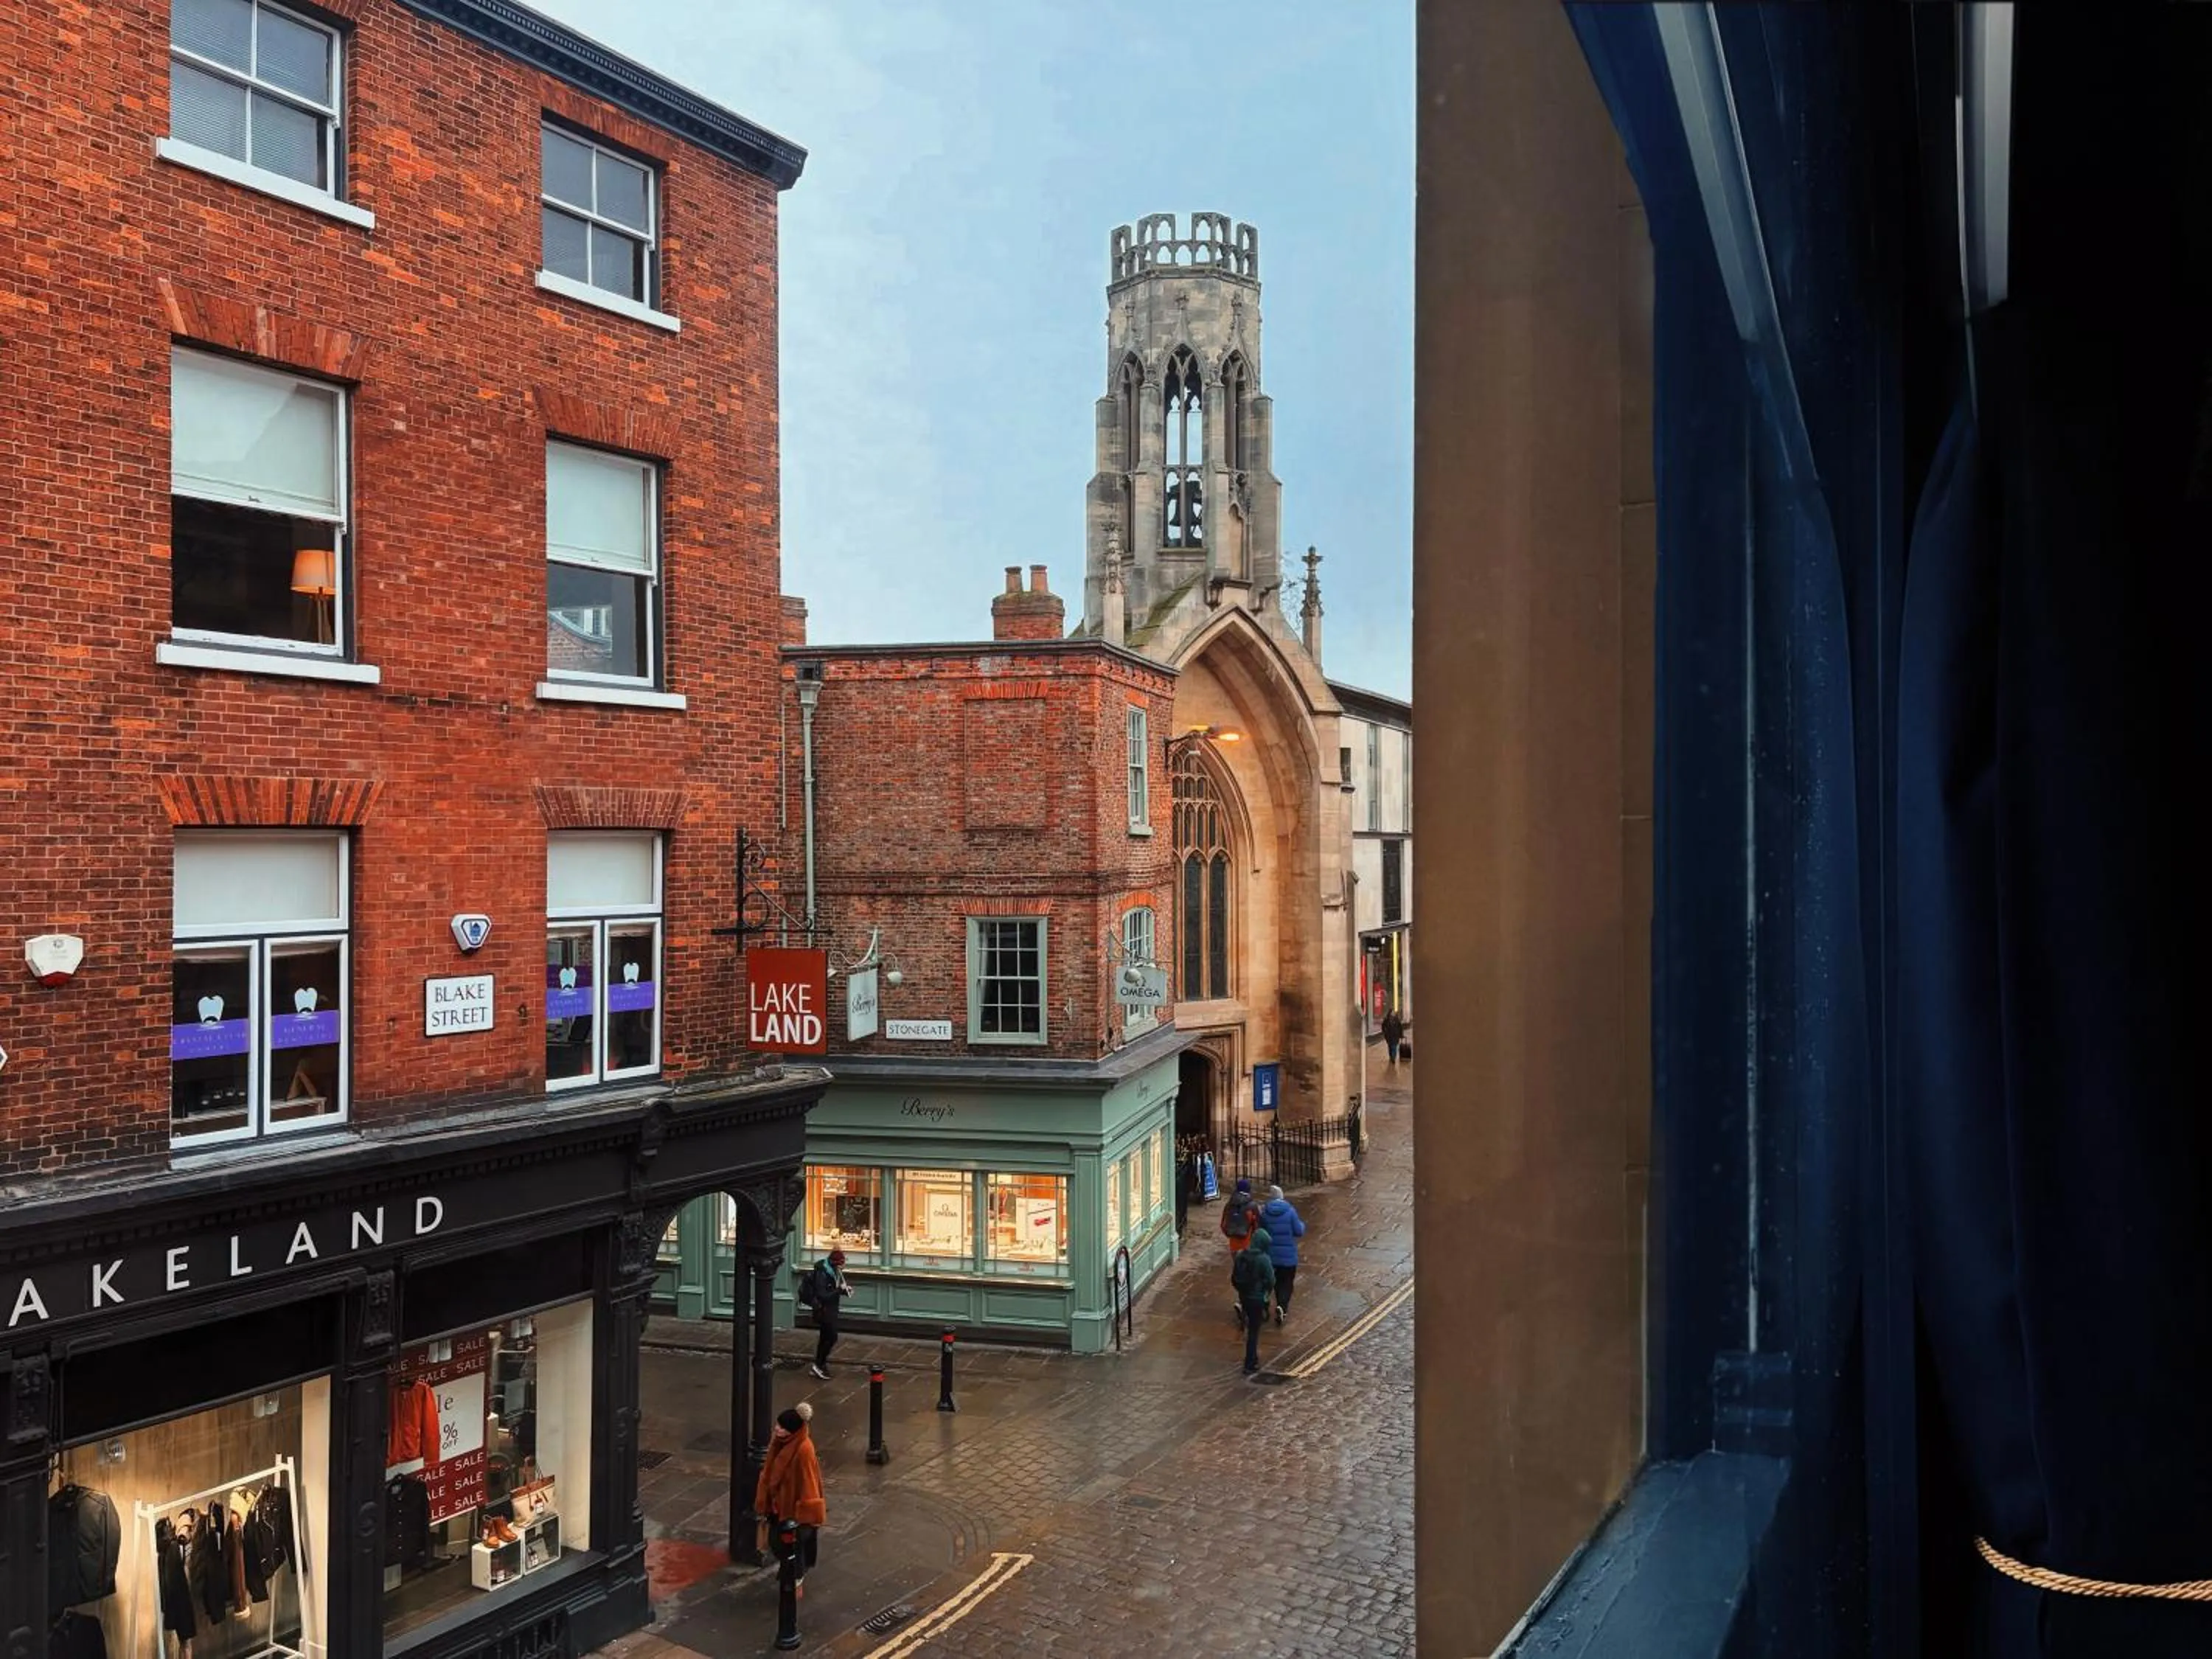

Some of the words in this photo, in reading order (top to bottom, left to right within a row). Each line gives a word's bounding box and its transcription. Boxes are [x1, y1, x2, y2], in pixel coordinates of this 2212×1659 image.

[434, 983, 485, 1004] BLAKE
[750, 982, 812, 1014] LAKE
[1120, 987, 1161, 998] OMEGA
[431, 1006, 489, 1028] STREET
[750, 1012, 822, 1046] LAND
[888, 1023, 949, 1035] STONEGATE
[900, 1096, 955, 1122] Berry's
[456, 1337, 484, 1354] SALE
[456, 1356, 485, 1374] SALE
[437, 1394, 454, 1413] le
[455, 1452, 484, 1472] SALE
[454, 1471, 484, 1490] SALE
[431, 1505, 447, 1520] LE
[454, 1490, 484, 1510] SALE
